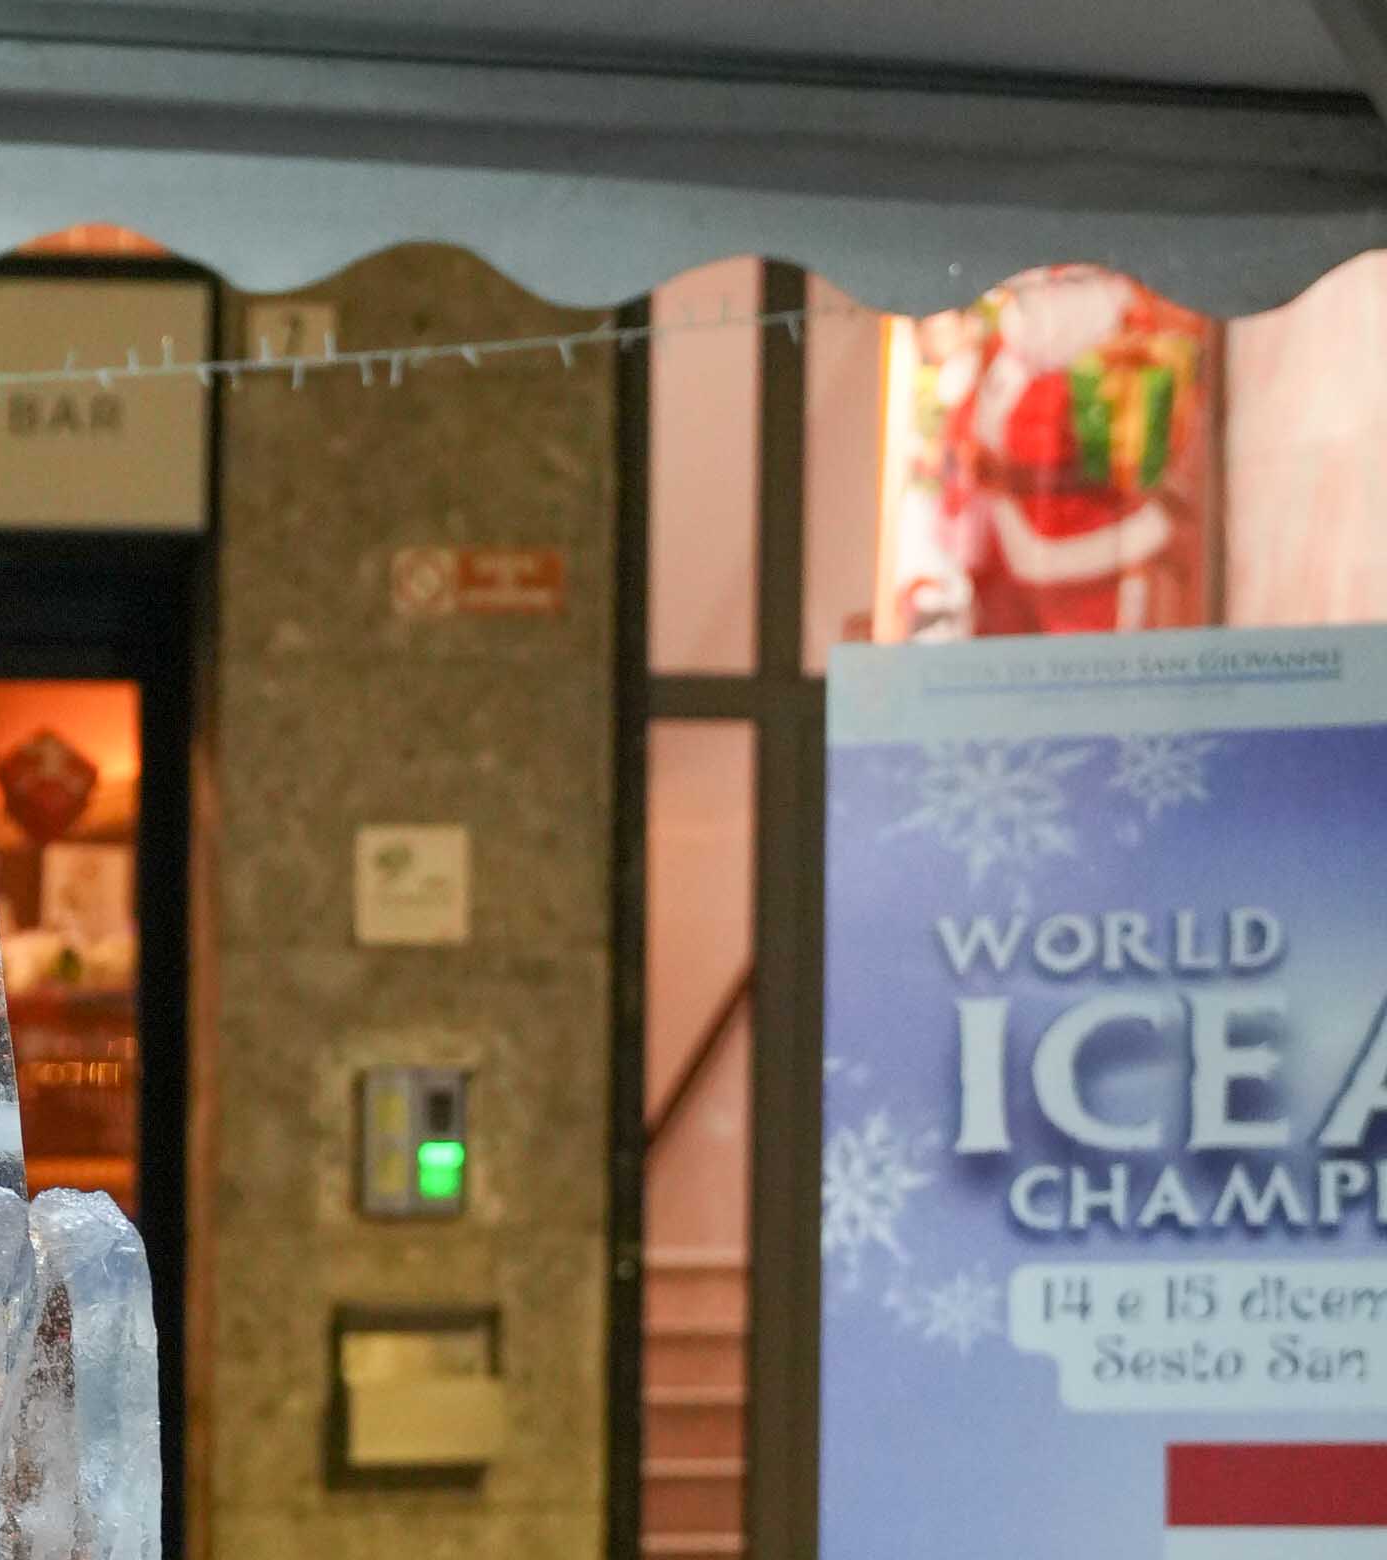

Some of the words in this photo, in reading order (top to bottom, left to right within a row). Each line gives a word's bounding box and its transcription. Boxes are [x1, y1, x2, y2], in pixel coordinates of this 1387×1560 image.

[8, 392, 121, 436] BAR
[936, 907, 1283, 975] WORLD
[1042, 1276, 1092, 1323] 14
[1116, 1291, 1141, 1321] e
[1164, 1274, 1216, 1322] 15
[1093, 1334, 1244, 1383] Sesto
[1267, 1333, 1368, 1383] San
